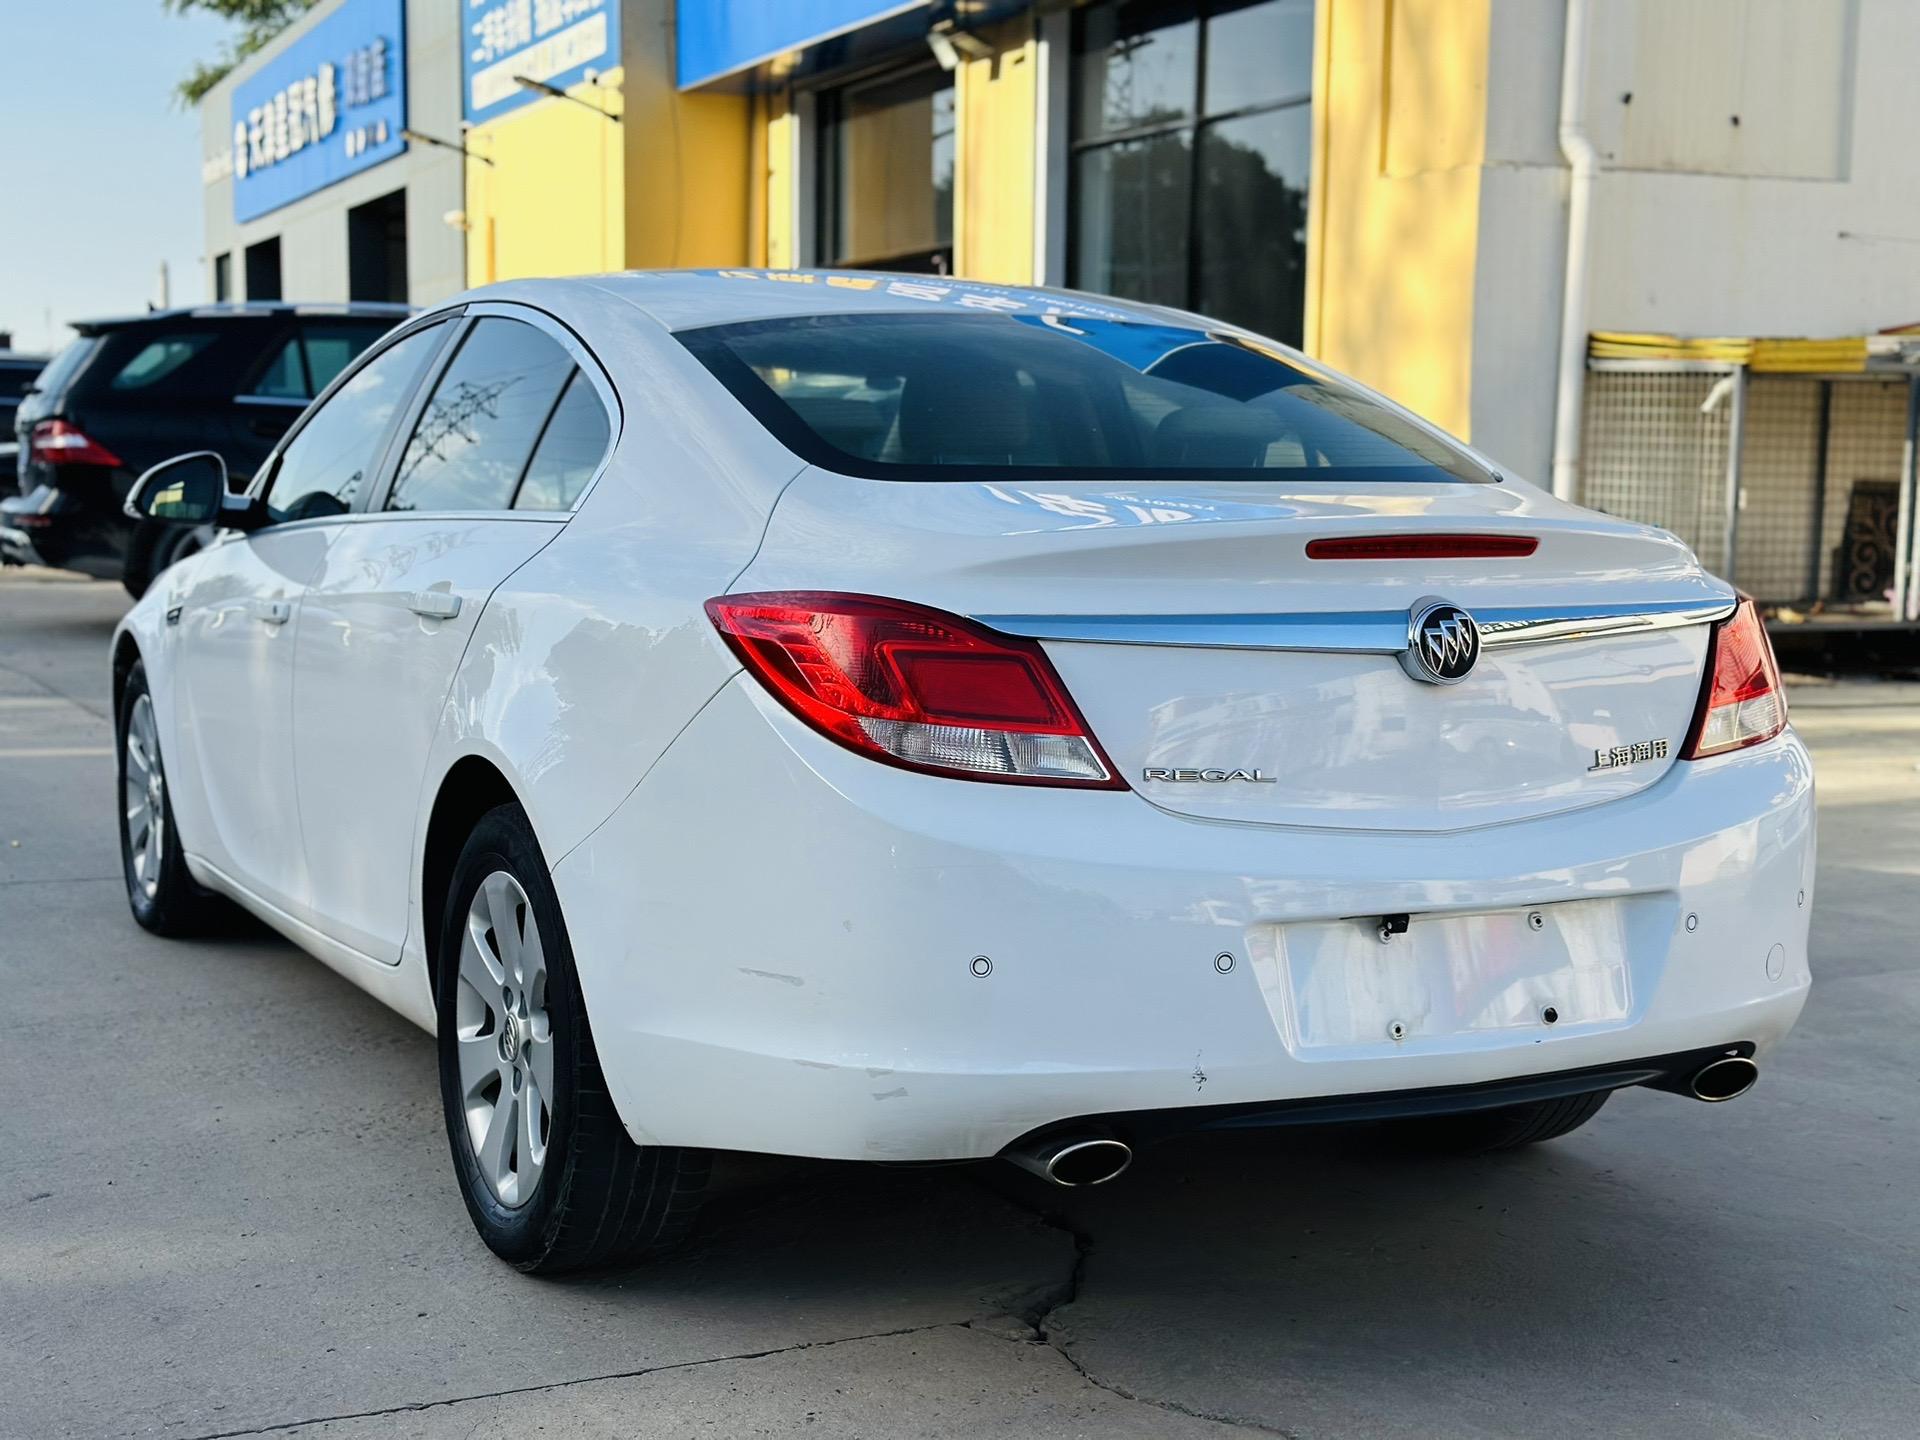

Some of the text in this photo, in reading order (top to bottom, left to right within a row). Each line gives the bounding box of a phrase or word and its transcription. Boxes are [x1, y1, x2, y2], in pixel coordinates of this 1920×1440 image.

[1587, 738, 1669, 772] 上海通用
[1143, 767, 1277, 783] REGAL
